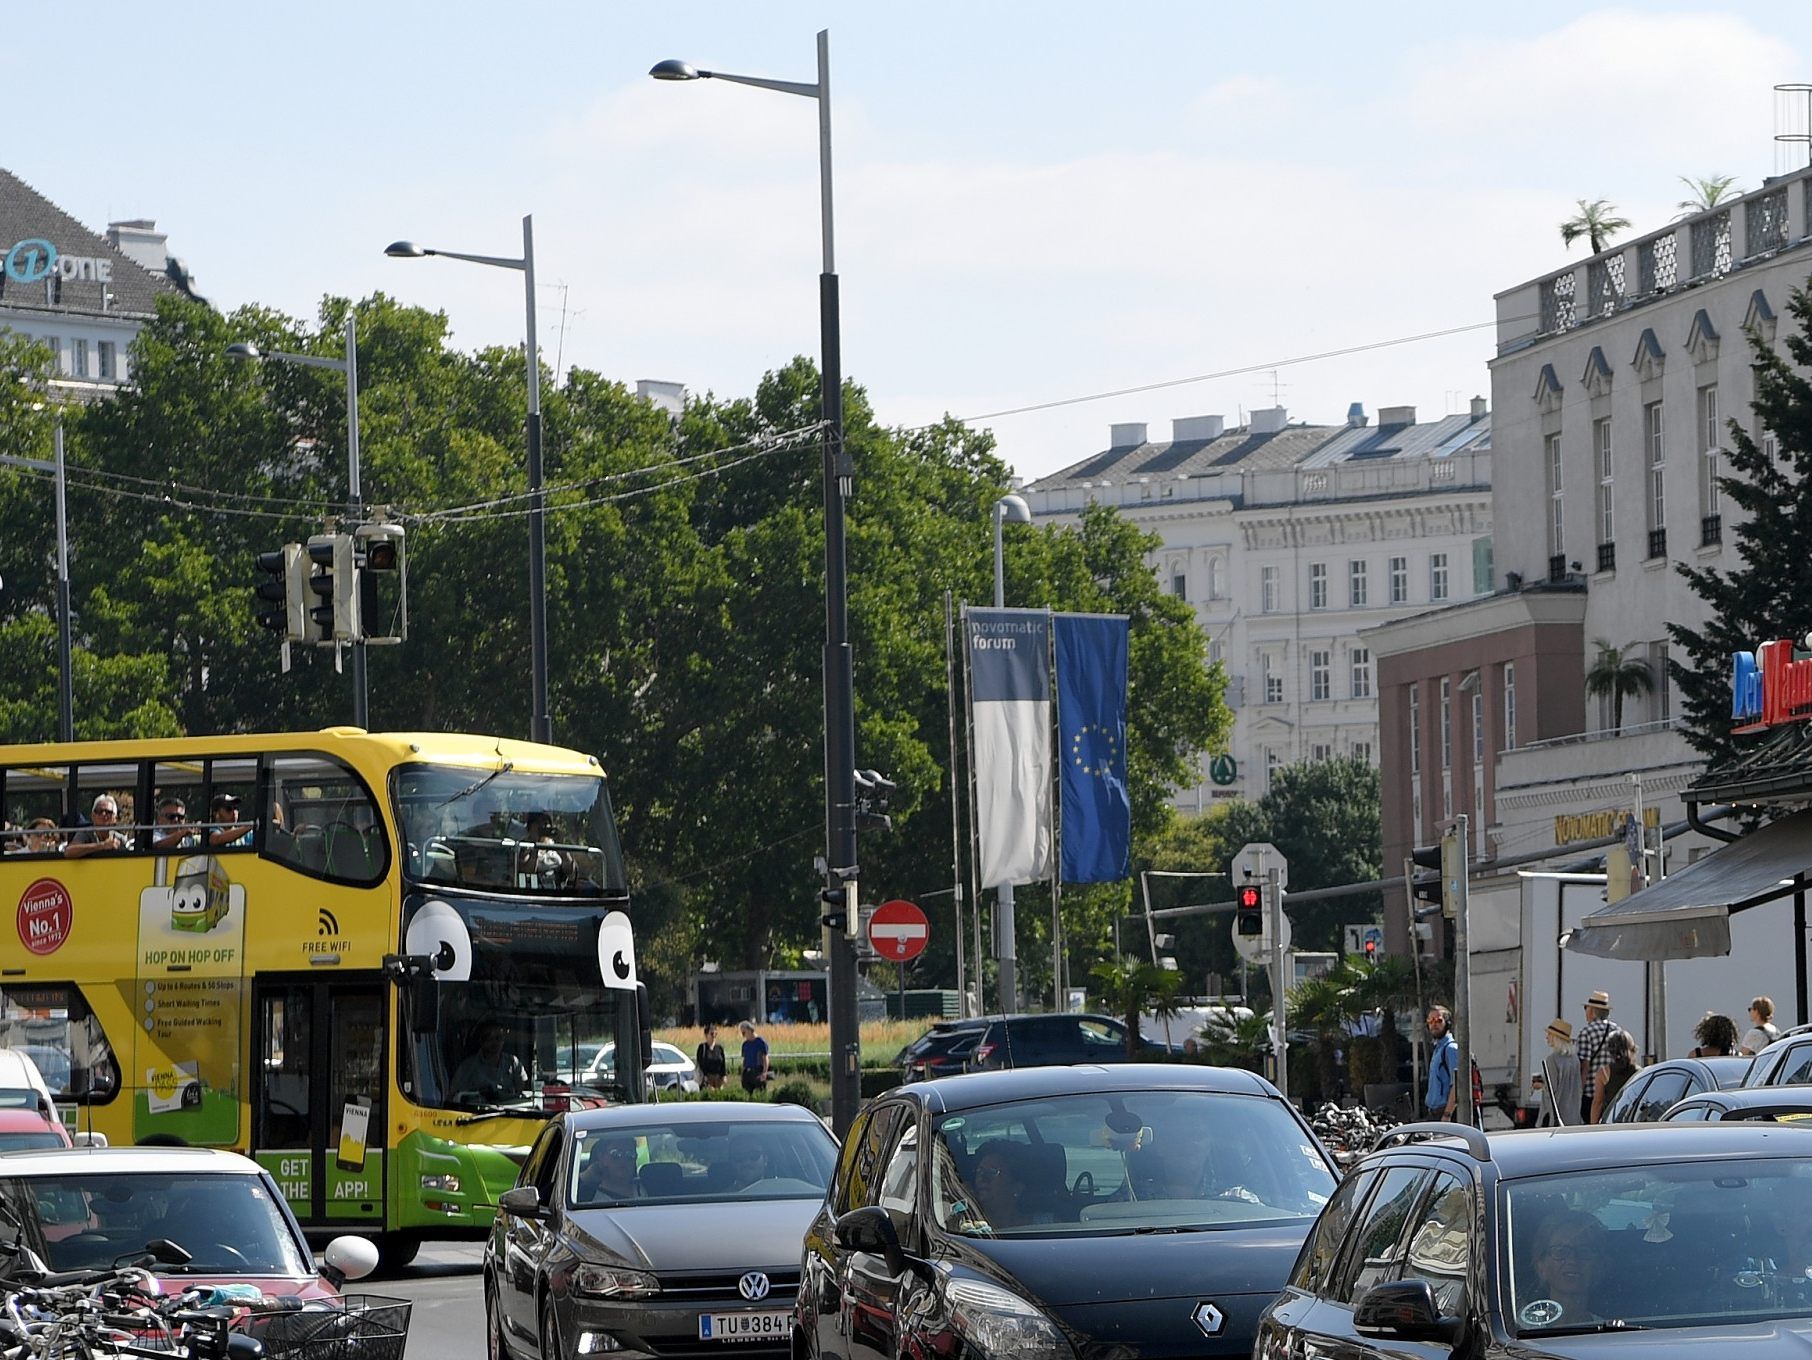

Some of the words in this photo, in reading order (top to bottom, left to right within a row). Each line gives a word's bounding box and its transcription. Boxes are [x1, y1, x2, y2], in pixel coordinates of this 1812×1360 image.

[972, 621, 1044, 634] novomatic
[973, 635, 1016, 650] forum
[23, 893, 63, 914] Vienna's
[302, 942, 327, 952] FREE
[330, 941, 351, 952] WIFI
[145, 951, 167, 964] HOP
[170, 951, 186, 964] ON
[188, 950, 211, 963] HOP
[214, 949, 235, 963] OFF
[345, 1107, 368, 1118] VIENNA
[281, 1159, 308, 1176] GET
[281, 1181, 308, 1199] THE
[334, 1181, 368, 1199] APP!
[717, 1317, 738, 1334] TU
[752, 1316, 783, 1333] 384
